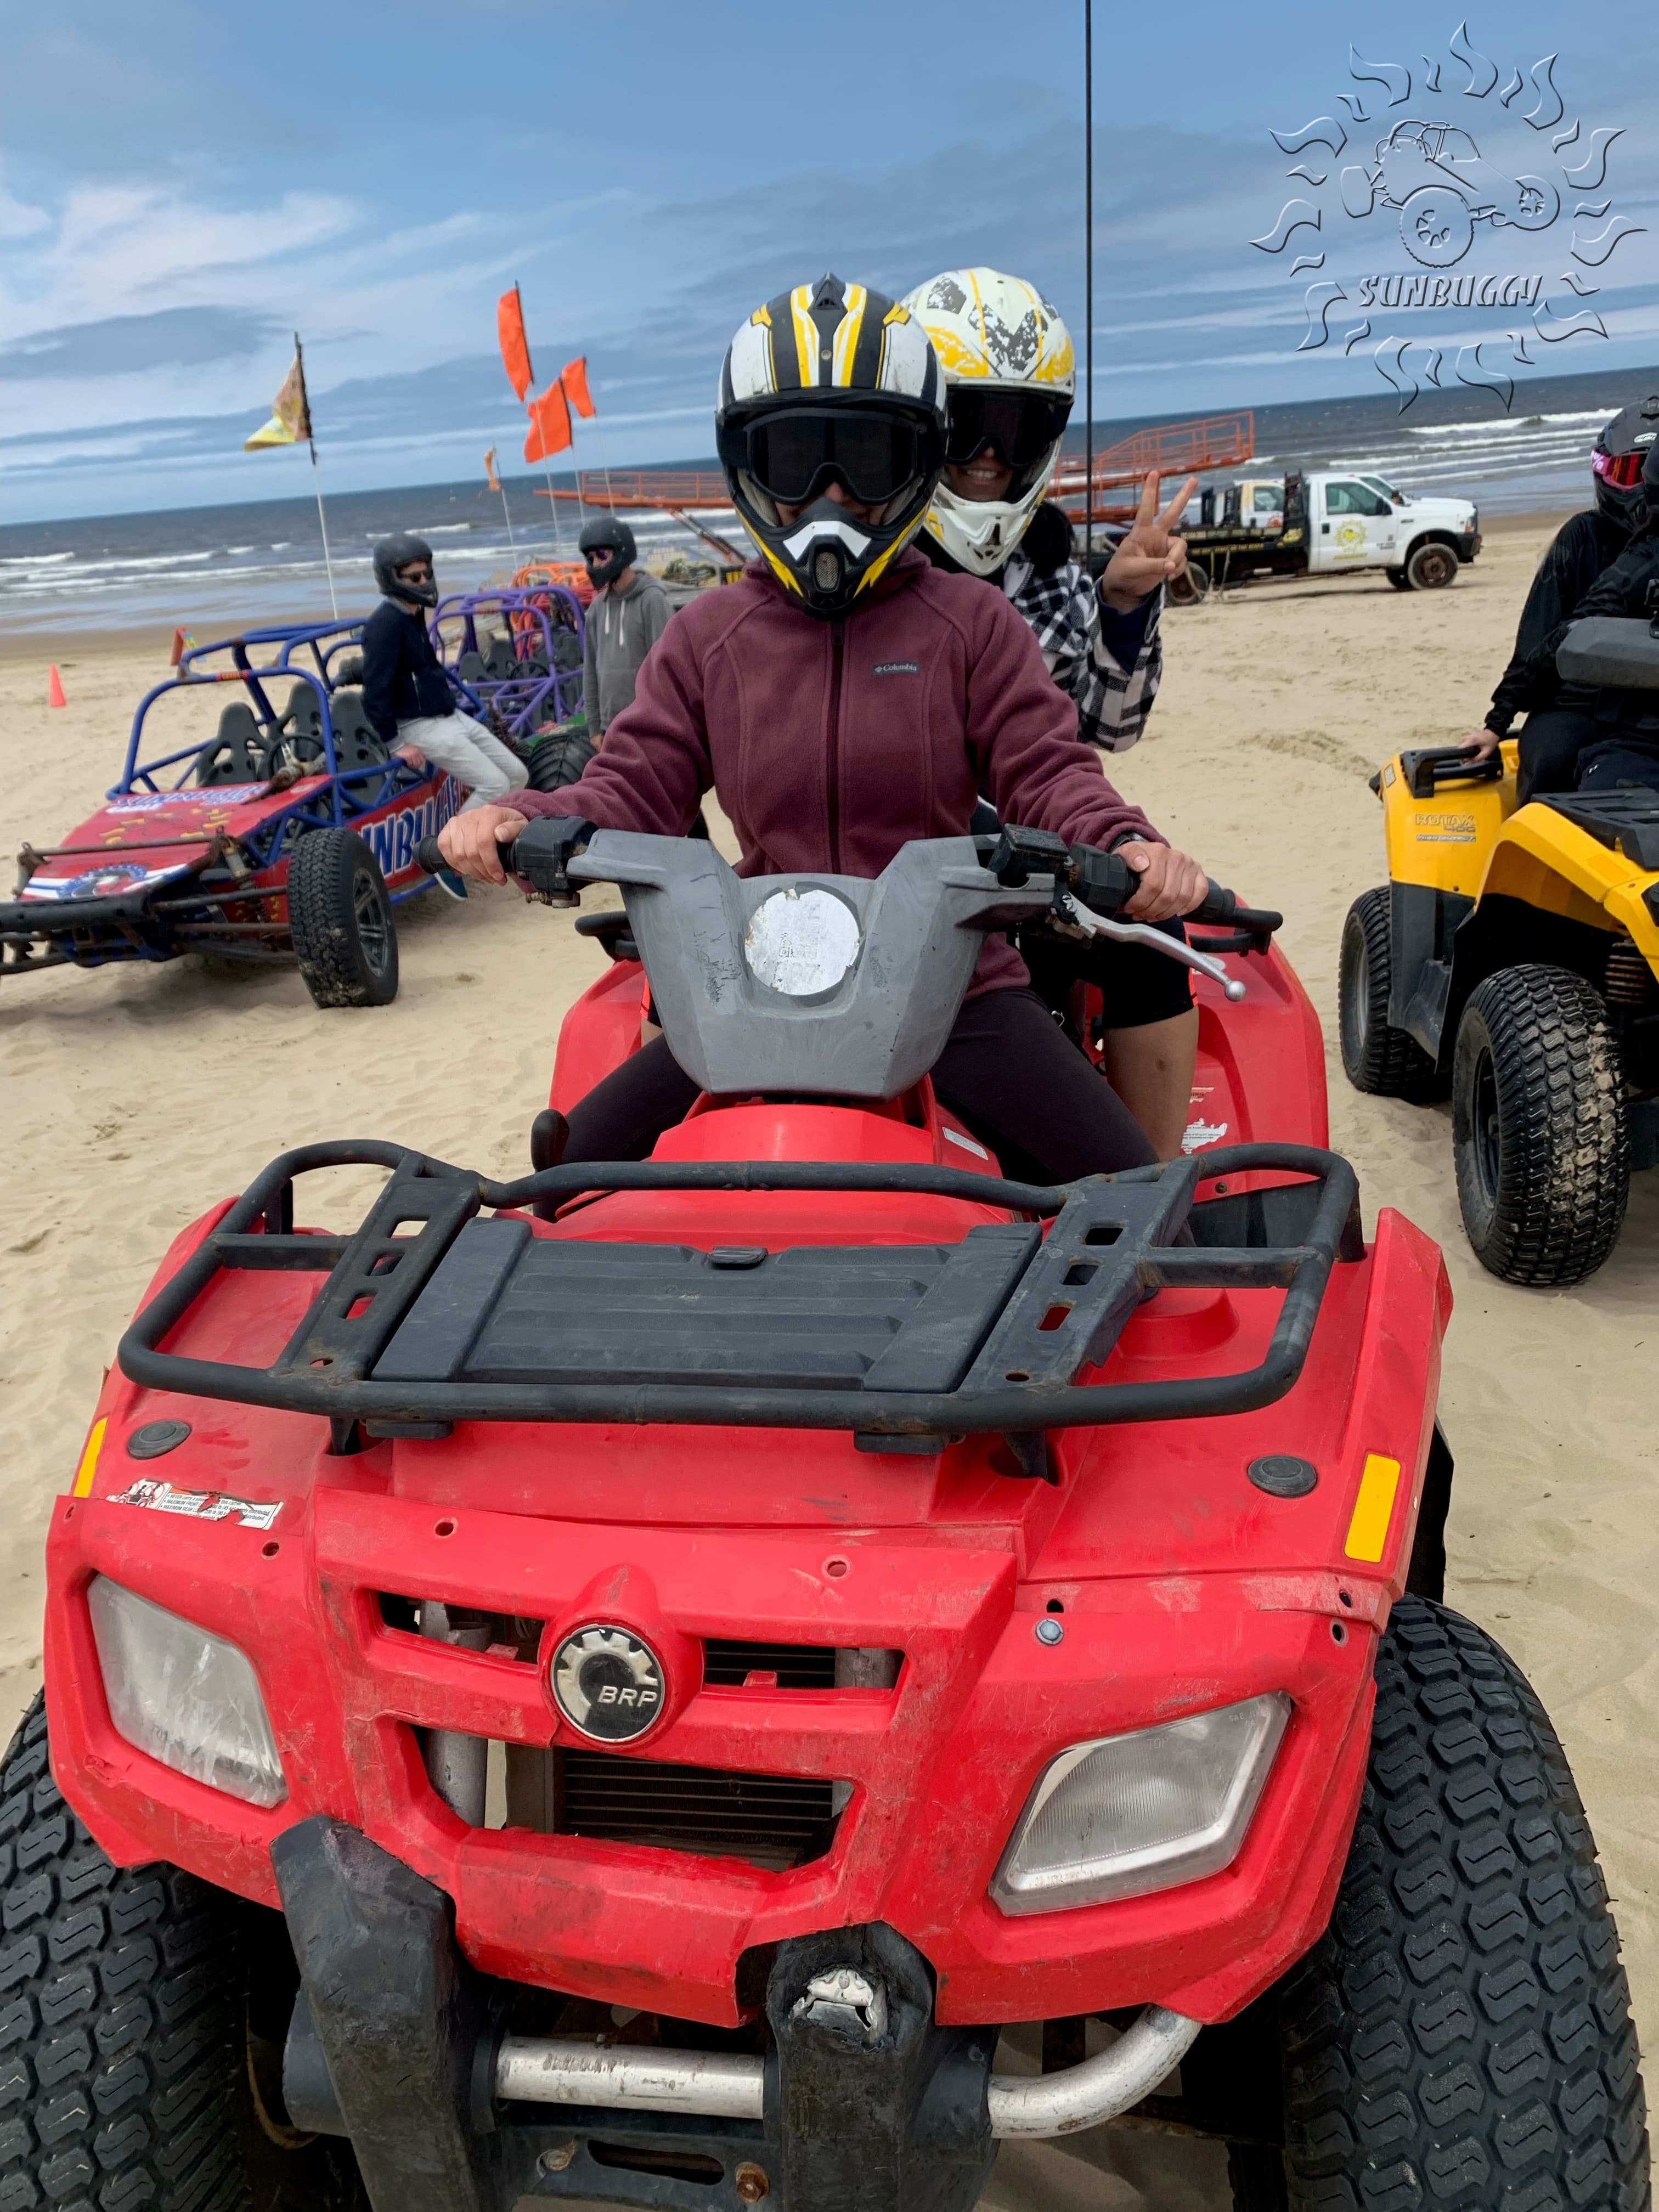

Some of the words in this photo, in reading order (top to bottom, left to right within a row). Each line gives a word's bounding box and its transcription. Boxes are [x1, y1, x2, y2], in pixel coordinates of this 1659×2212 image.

[883, 663, 917, 671] Columbia
[1415, 814, 1476, 826] ROTAX
[597, 1685, 658, 1708] BRP
[1147, 1737, 1169, 1749] TOP
